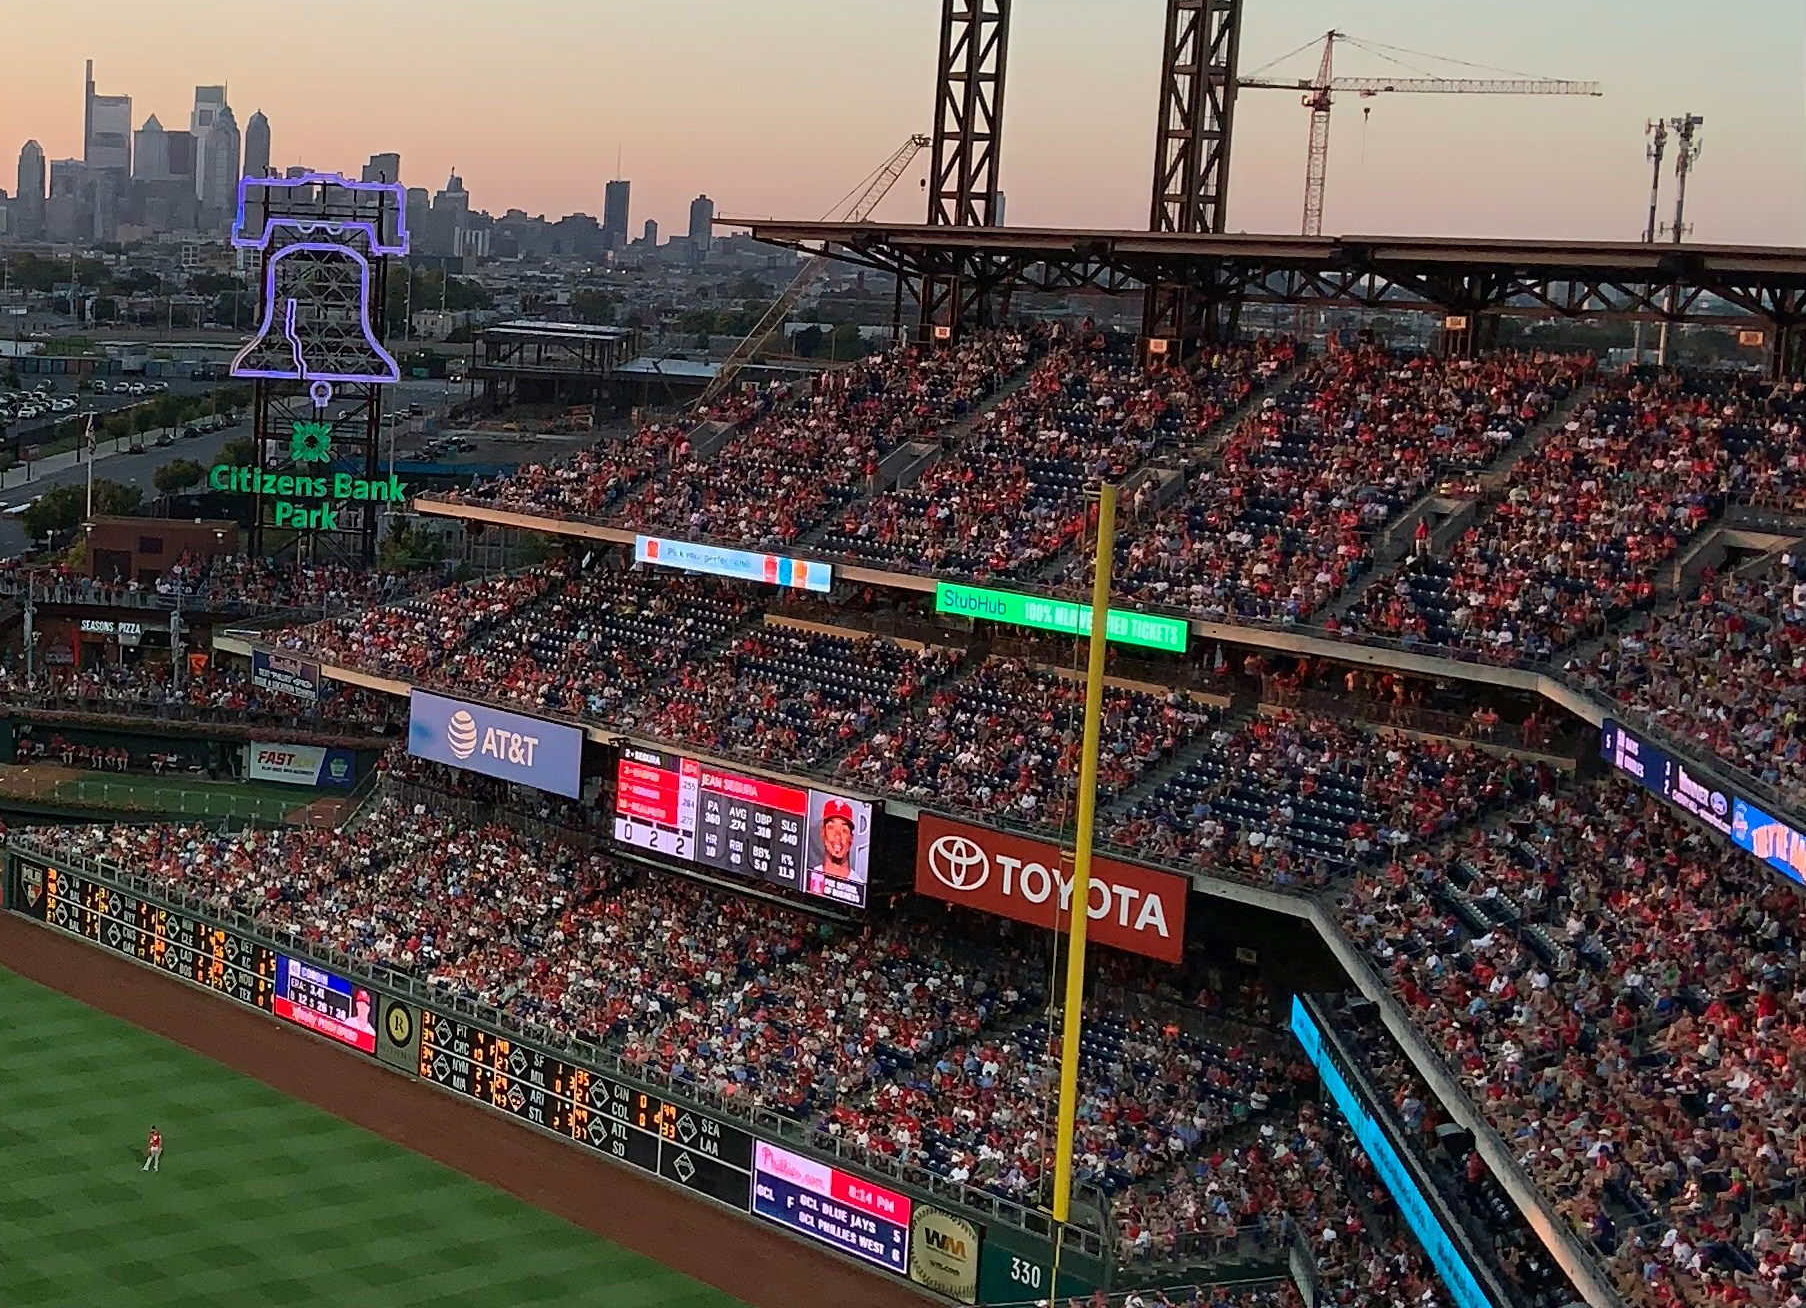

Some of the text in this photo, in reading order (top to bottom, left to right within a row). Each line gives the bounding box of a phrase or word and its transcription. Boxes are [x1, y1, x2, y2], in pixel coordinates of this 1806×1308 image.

[209, 464, 408, 502] Citizens Bank
[276, 501, 337, 530] Park
[944, 590, 1006, 615] StubHub
[81, 620, 141, 634] SEASONS PIZZA
[1025, 602, 1178, 645] 100% TICKETS
[482, 726, 540, 767] AT&T
[258, 751, 296, 766] FAST
[996, 854, 1170, 938] TOYOTA
[456, 1024, 468, 1038] PIT
[454, 1040, 469, 1055] CHC
[452, 1058, 468, 1074] NYM
[534, 1053, 544, 1068] SF
[530, 1069, 545, 1087] MIL
[530, 1090, 544, 1106] ARI
[614, 1084, 629, 1102] CIN
[528, 1106, 544, 1124] STL
[612, 1102, 629, 1120] COL
[611, 1122, 628, 1140] ATL
[701, 1119, 720, 1139] SEA
[612, 1140, 625, 1156] SD
[700, 1136, 718, 1157] LAA
[876, 1195, 895, 1214] PM
[822, 1201, 847, 1223] BLUE
[851, 1214, 876, 1234] JAYS
[818, 1218, 856, 1244] PHILLIES
[858, 1234, 885, 1256] WEST
[924, 1226, 966, 1259] WM
[1010, 1256, 1041, 1290] 330
